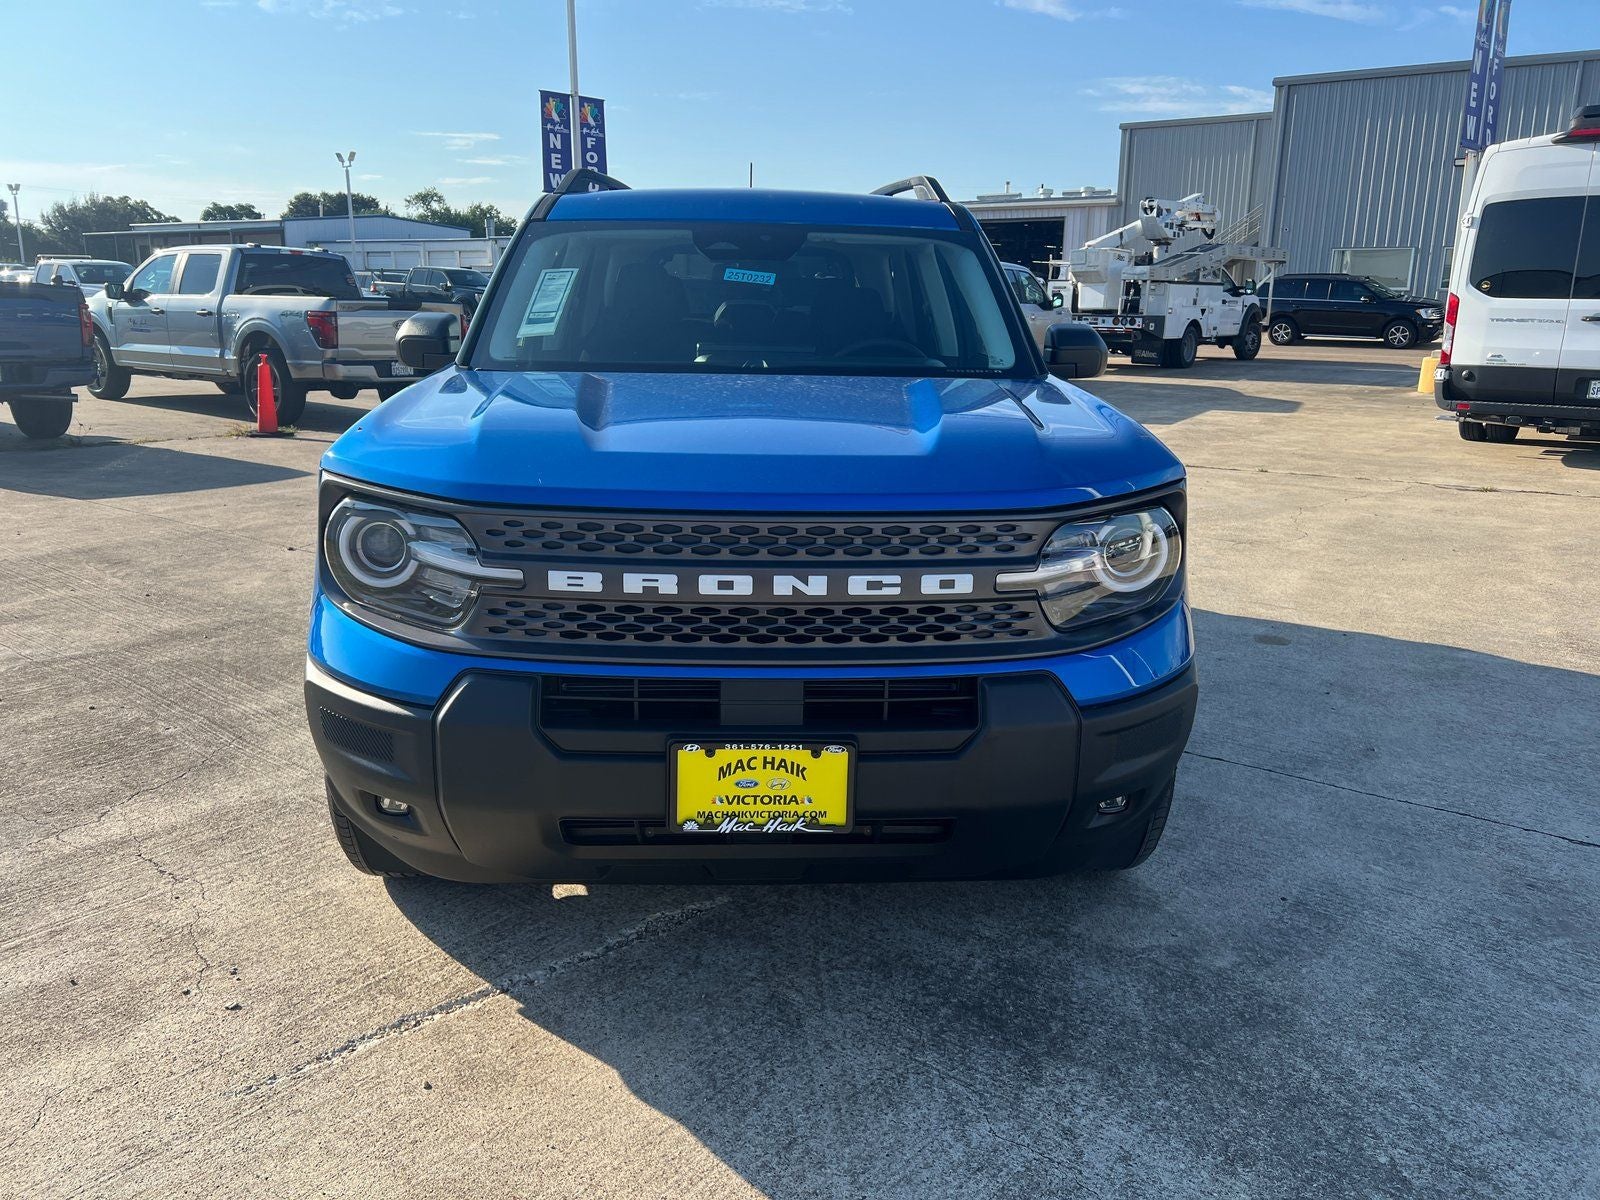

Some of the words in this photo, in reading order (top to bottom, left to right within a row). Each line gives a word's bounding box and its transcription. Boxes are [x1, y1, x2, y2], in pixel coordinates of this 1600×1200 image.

[1466, 48, 1482, 141] NEW
[1486, 59, 1499, 145] FORD
[549, 133, 566, 189] NEW
[727, 271, 771, 283] 25T0232
[547, 570, 974, 596] BRONCO
[718, 756, 757, 781] MAC
[762, 756, 807, 781] HAIK
[724, 794, 800, 806] VICTORIA
[717, 817, 757, 833] Mac
[762, 817, 808, 833] Haik
